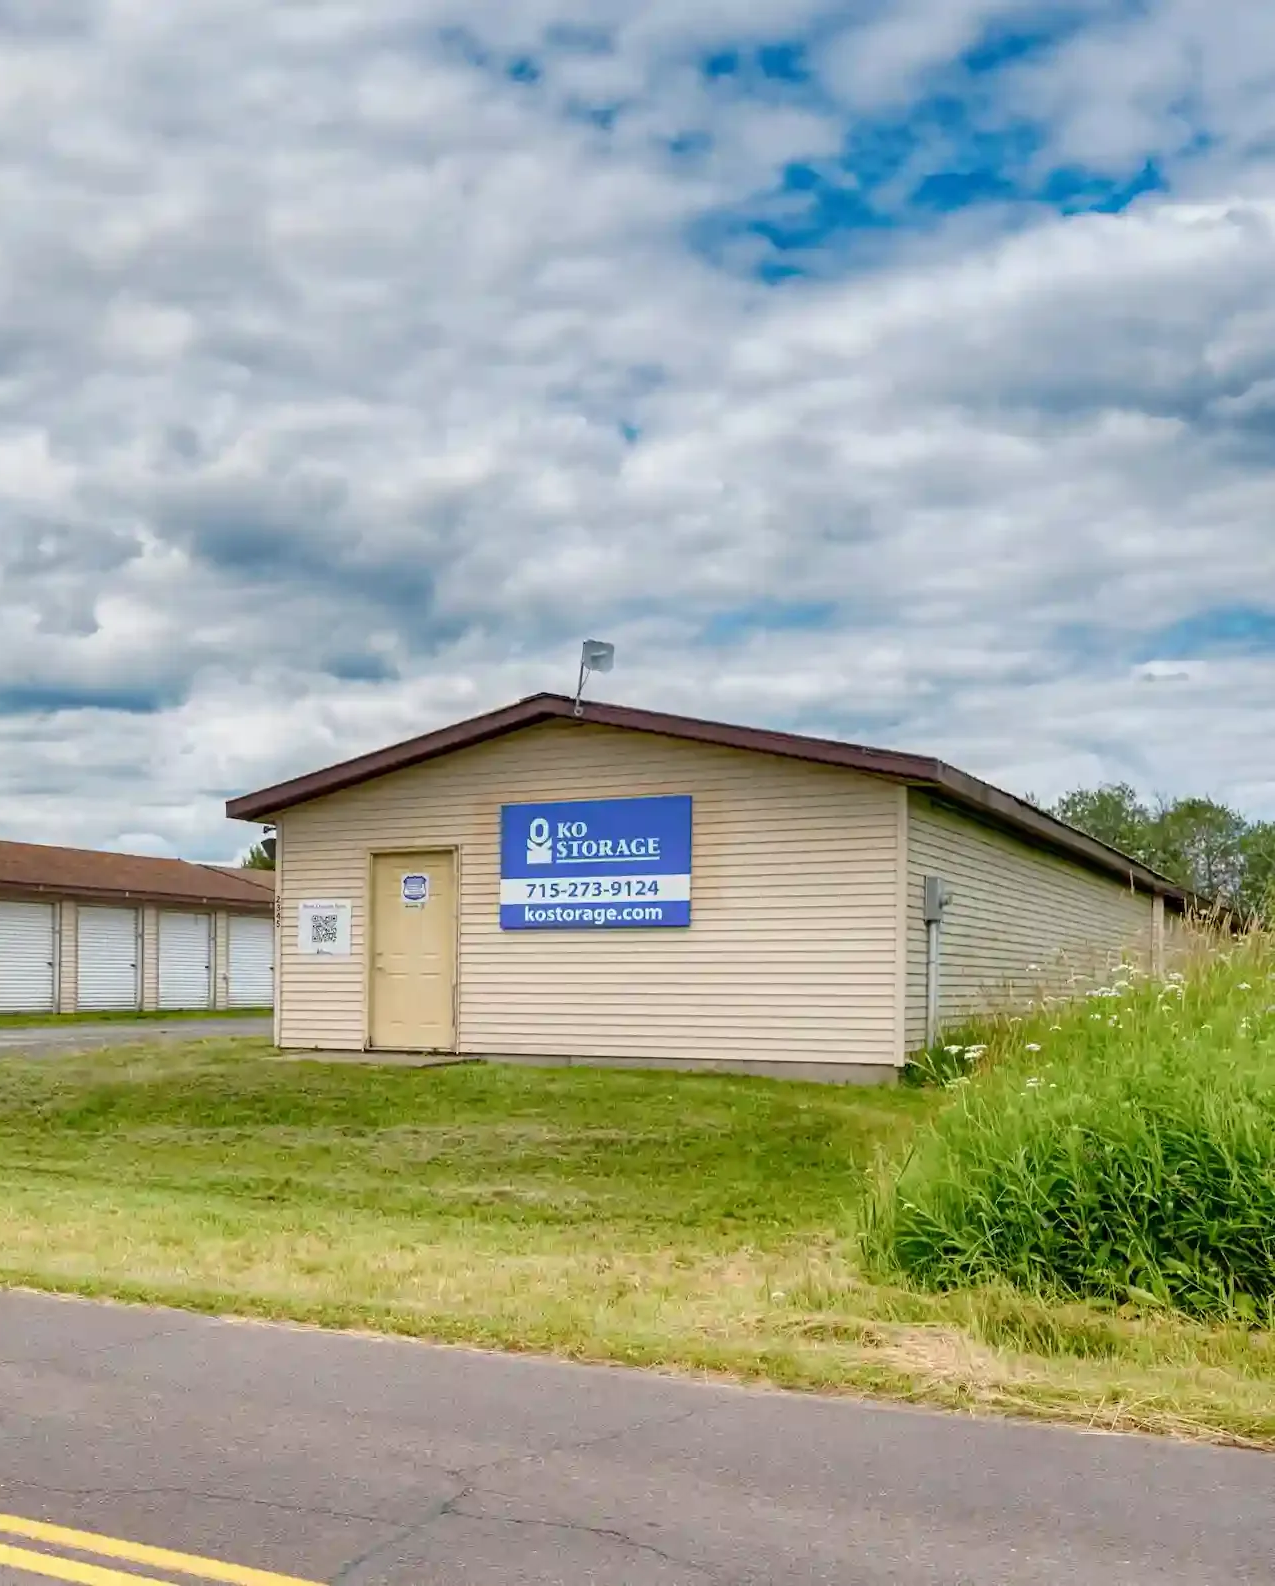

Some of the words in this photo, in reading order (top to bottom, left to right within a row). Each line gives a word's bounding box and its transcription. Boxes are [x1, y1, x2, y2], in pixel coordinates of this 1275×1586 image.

[556, 821, 588, 839] KO
[556, 837, 661, 858] STORAGE
[526, 880, 659, 899] 715-273-9124
[524, 905, 663, 925] kostorage.com
